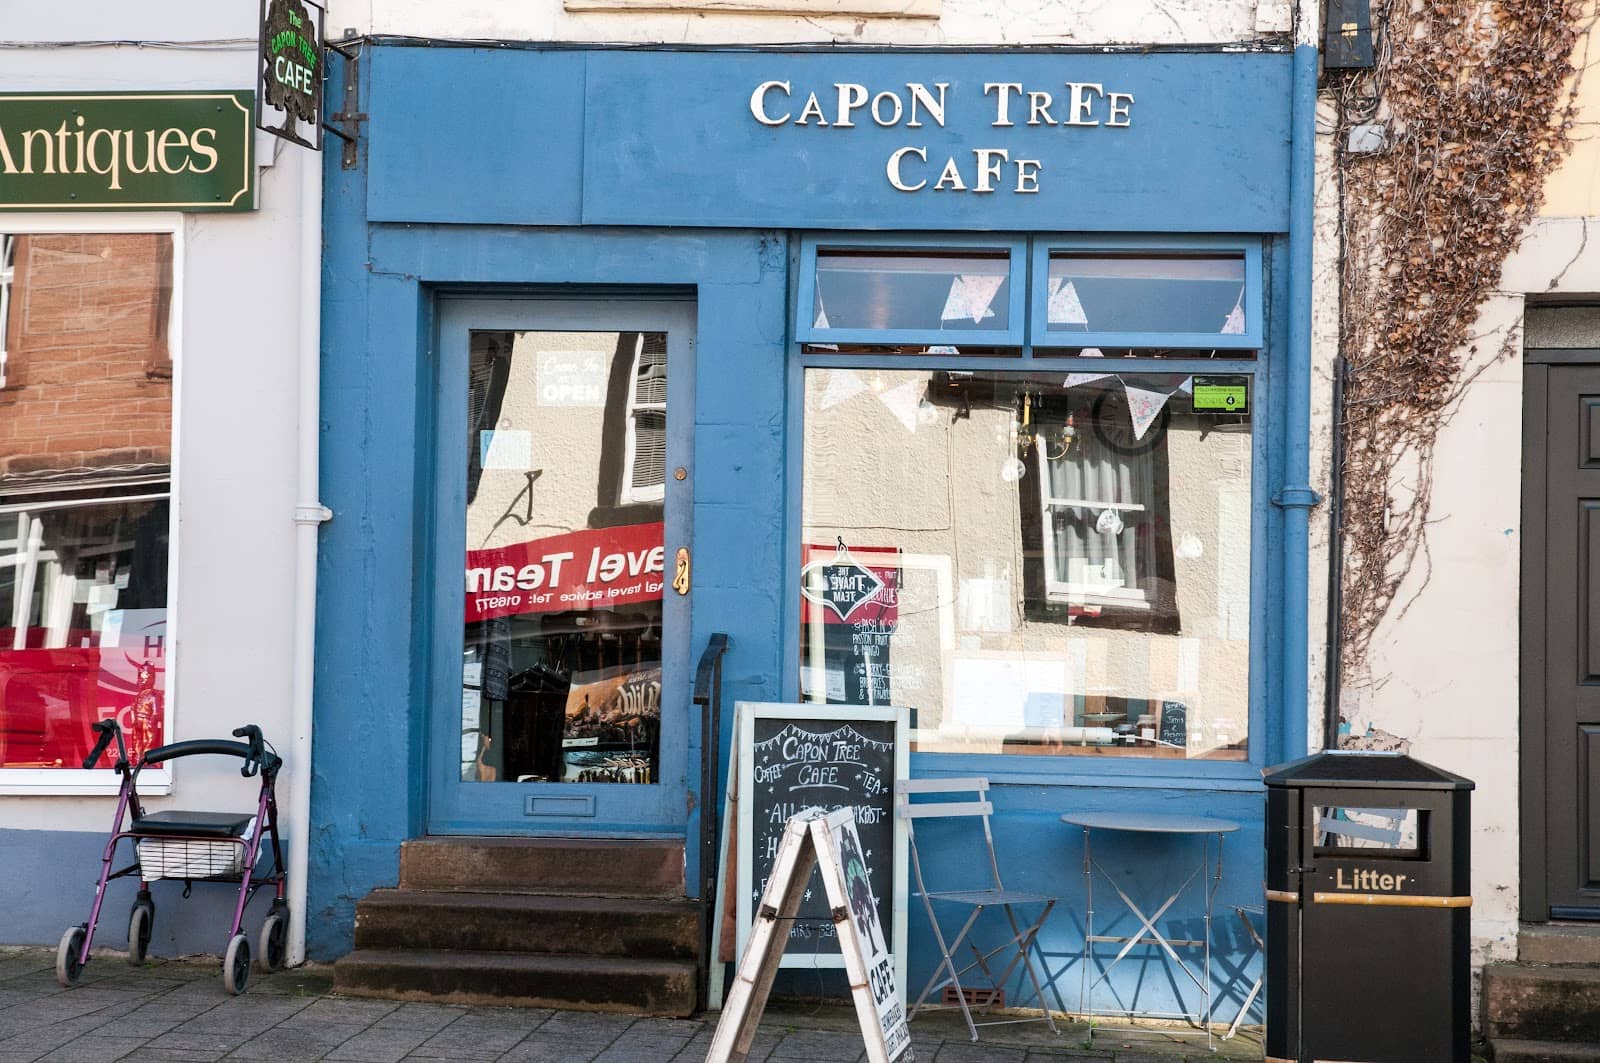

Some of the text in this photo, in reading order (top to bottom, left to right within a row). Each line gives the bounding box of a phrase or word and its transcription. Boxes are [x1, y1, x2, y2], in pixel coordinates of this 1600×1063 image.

[288, 9, 302, 28] The
[271, 31, 317, 70] CAPON TREE
[275, 56, 312, 95] CAFE
[750, 80, 1135, 128] CAPON TREE
[886, 146, 1042, 193] CAFE
[543, 384, 600, 401] OPEN
[783, 737, 861, 761] CAPON TREE
[754, 764, 782, 783] COFFEE
[798, 765, 838, 785] CAFE
[862, 770, 881, 794] TEA
[1336, 868, 1406, 890] Litter
[870, 959, 895, 1006] CAFE
